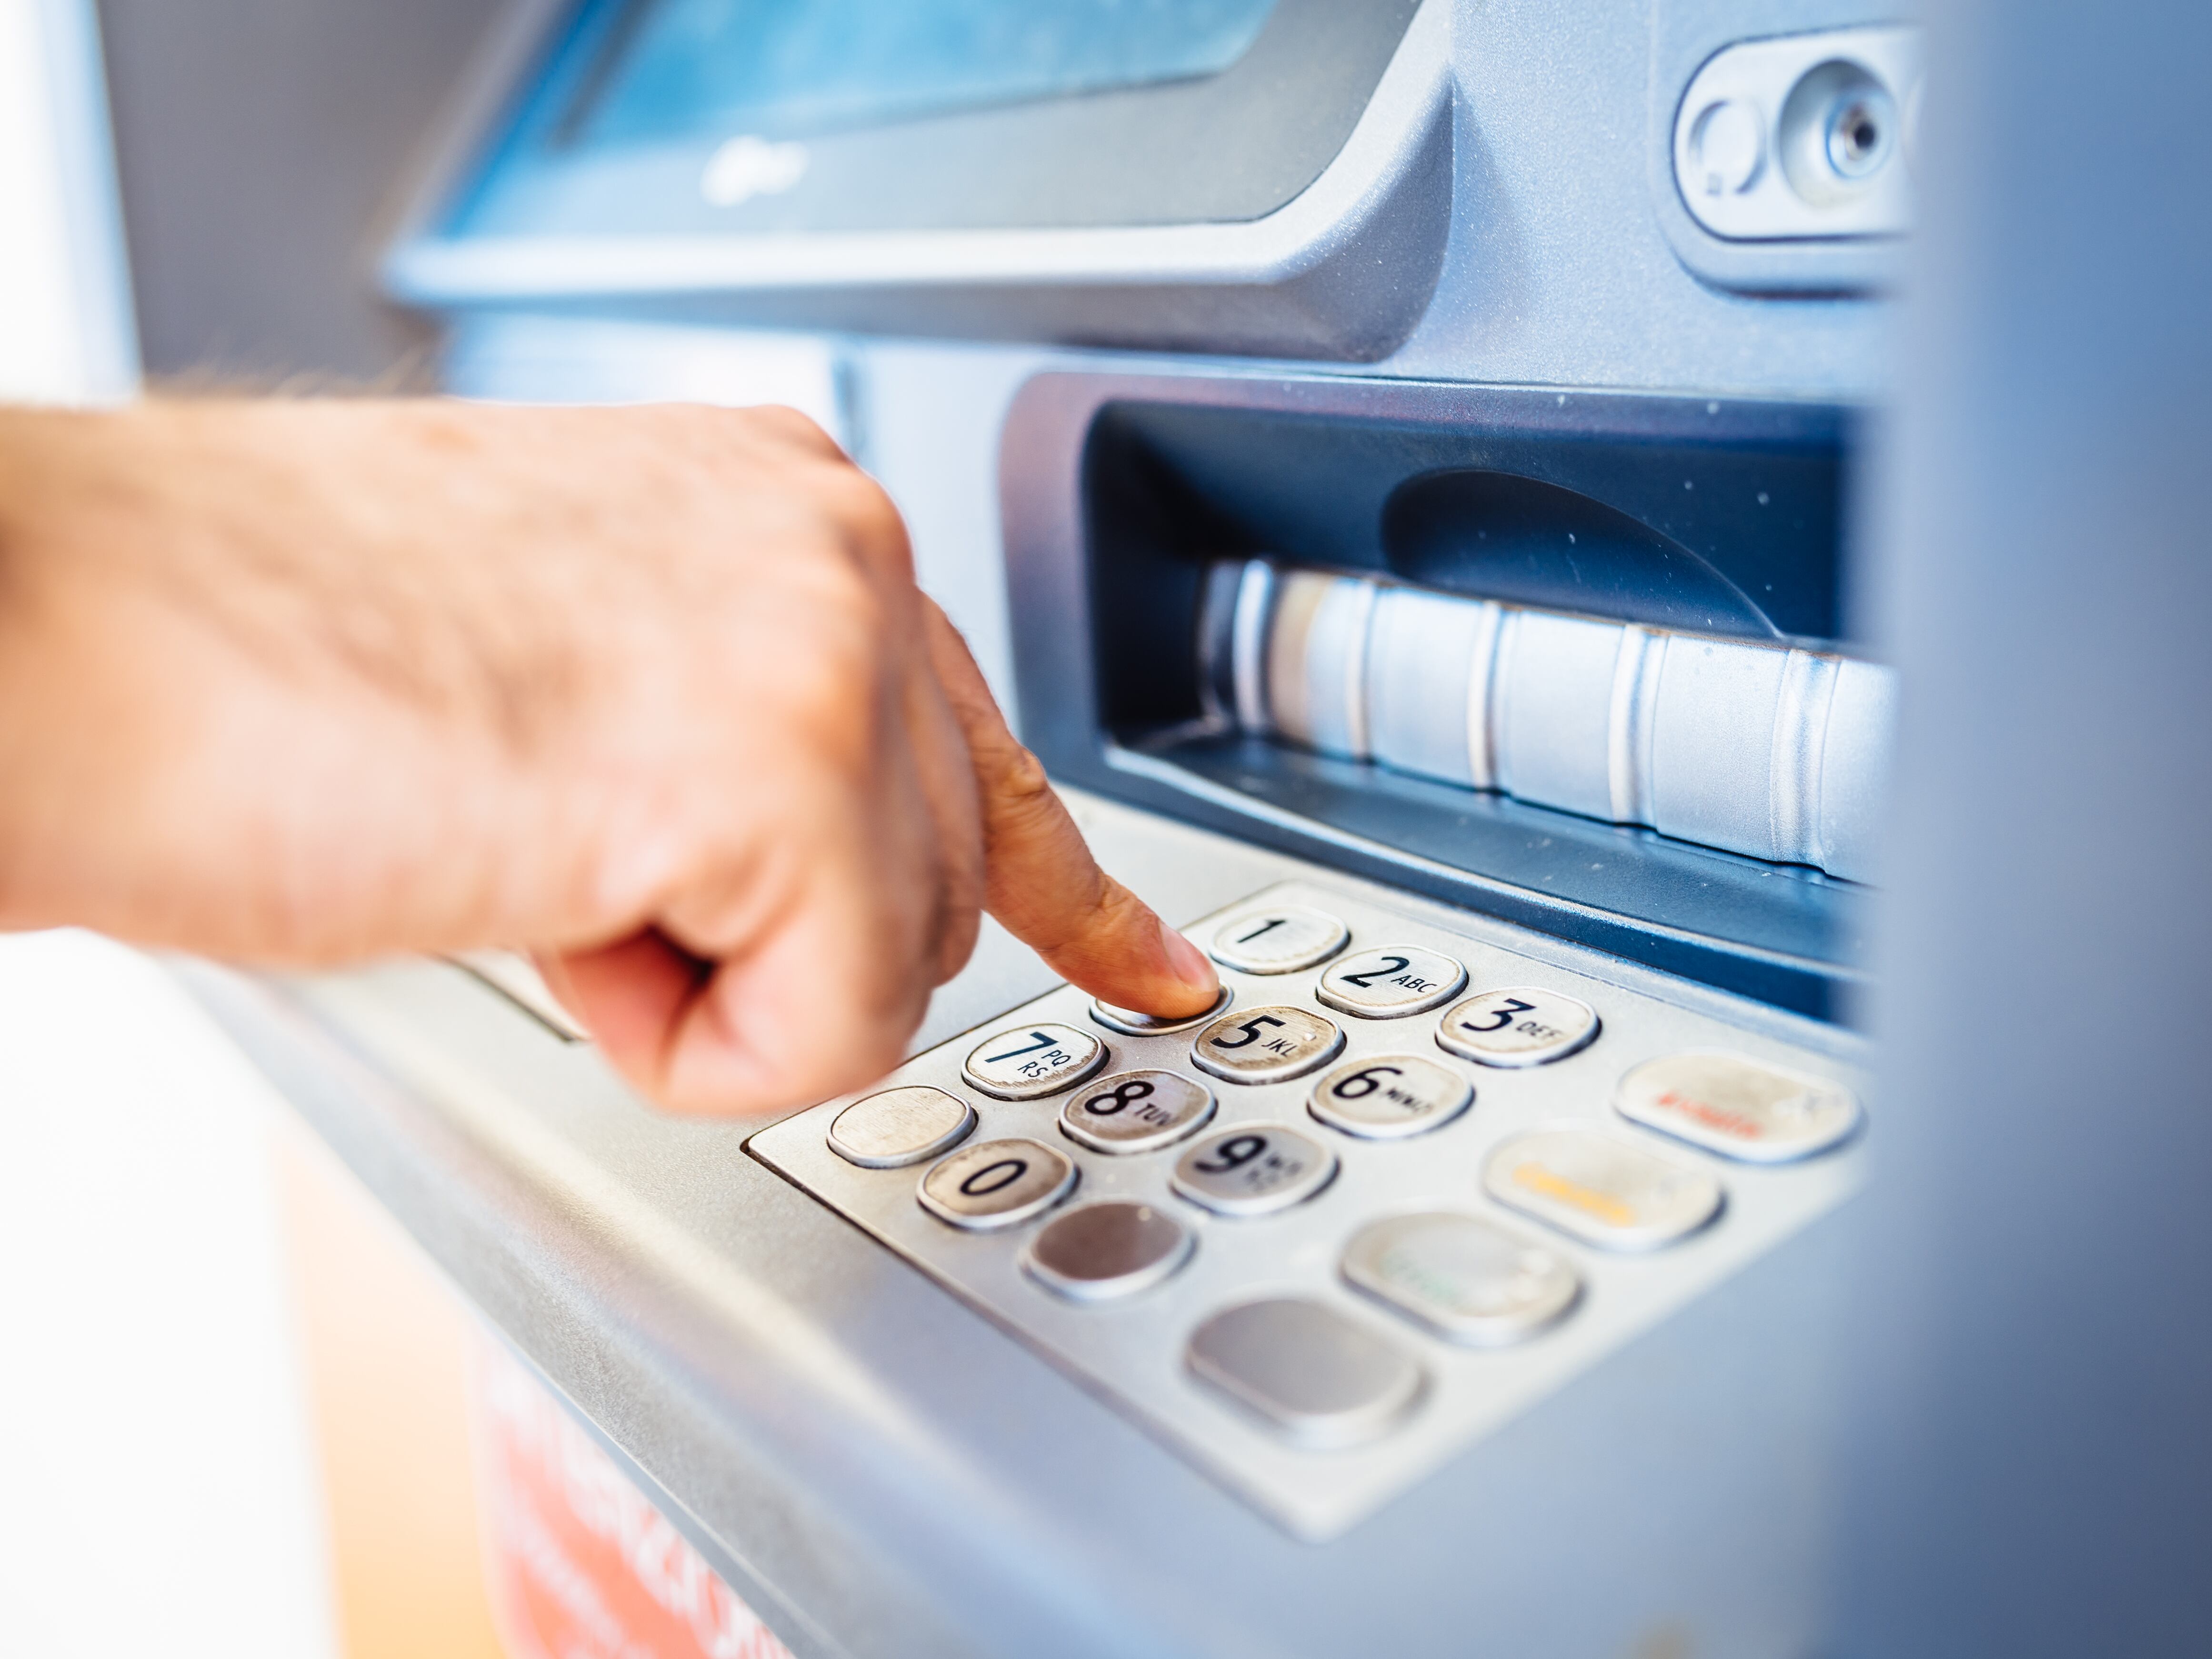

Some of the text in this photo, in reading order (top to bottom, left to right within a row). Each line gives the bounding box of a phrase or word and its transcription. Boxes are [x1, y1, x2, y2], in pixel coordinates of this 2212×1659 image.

[1237, 919, 1286, 943] 1
[1340, 957, 1437, 993] 2 ABC
[1210, 1015, 1298, 1057] 5 JKL
[1460, 998, 1563, 1040] 3 DEF
[984, 1031, 1059, 1063] 7
[1041, 1049, 1071, 1067] PQ
[1017, 1061, 1049, 1078] RS
[1332, 1067, 1403, 1099] 6
[1084, 1080, 1155, 1115] 8
[1193, 1136, 1268, 1174] 9
[960, 1159, 1028, 1197] 0
